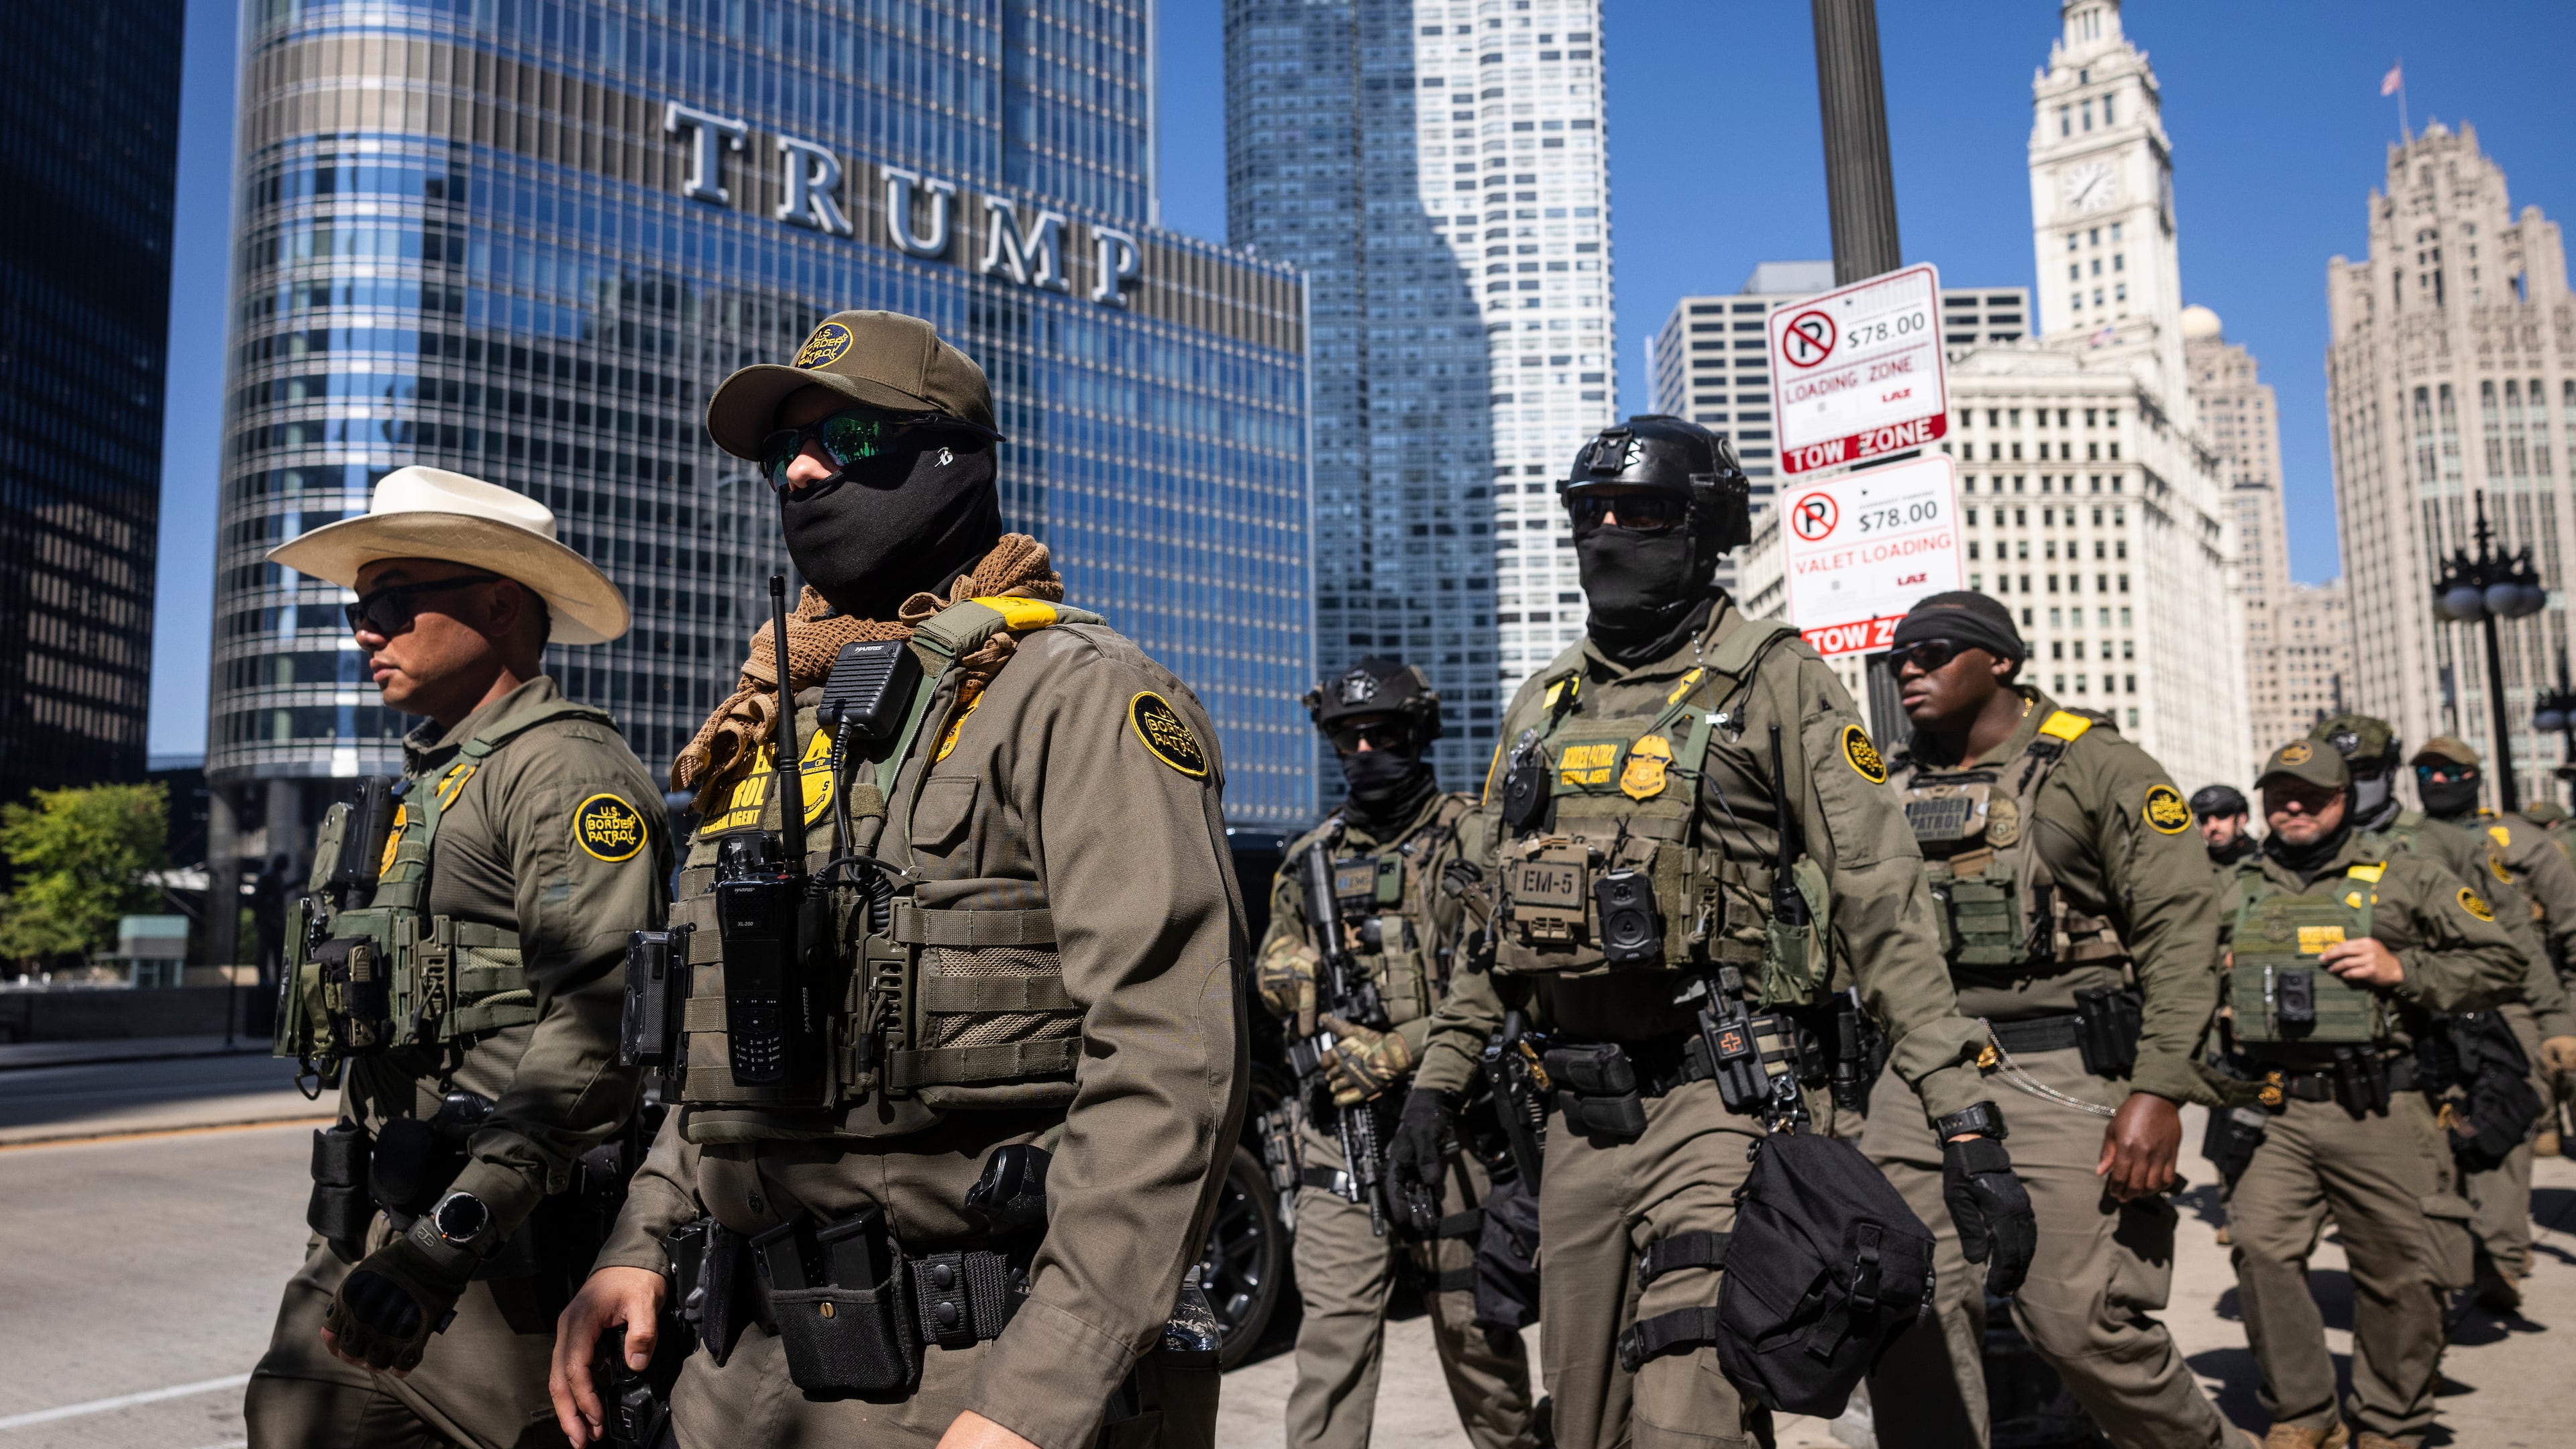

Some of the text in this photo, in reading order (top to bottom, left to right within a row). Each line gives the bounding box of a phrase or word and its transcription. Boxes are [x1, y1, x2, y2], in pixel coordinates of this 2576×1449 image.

[663, 100, 1142, 307] TRUMP
[1847, 312, 1924, 348] $78.00
[1784, 356, 1913, 404] LOADING ZONE
[1790, 418, 1935, 472] TOW ZONE
[1860, 500, 1937, 532] $78.00
[1795, 533, 1951, 575] VALET LOADING
[854, 645, 884, 655] HARRIS
[1807, 623, 1869, 653] TOW
[600, 806, 621, 816] U.S.
[729, 808, 761, 828] AGENT
[1913, 799, 1964, 816] BORDER
[588, 816, 635, 830] BORDER
[1911, 814, 1960, 830] PATROL
[588, 830, 637, 843] PATROL
[1523, 870, 1572, 894] EM-5
